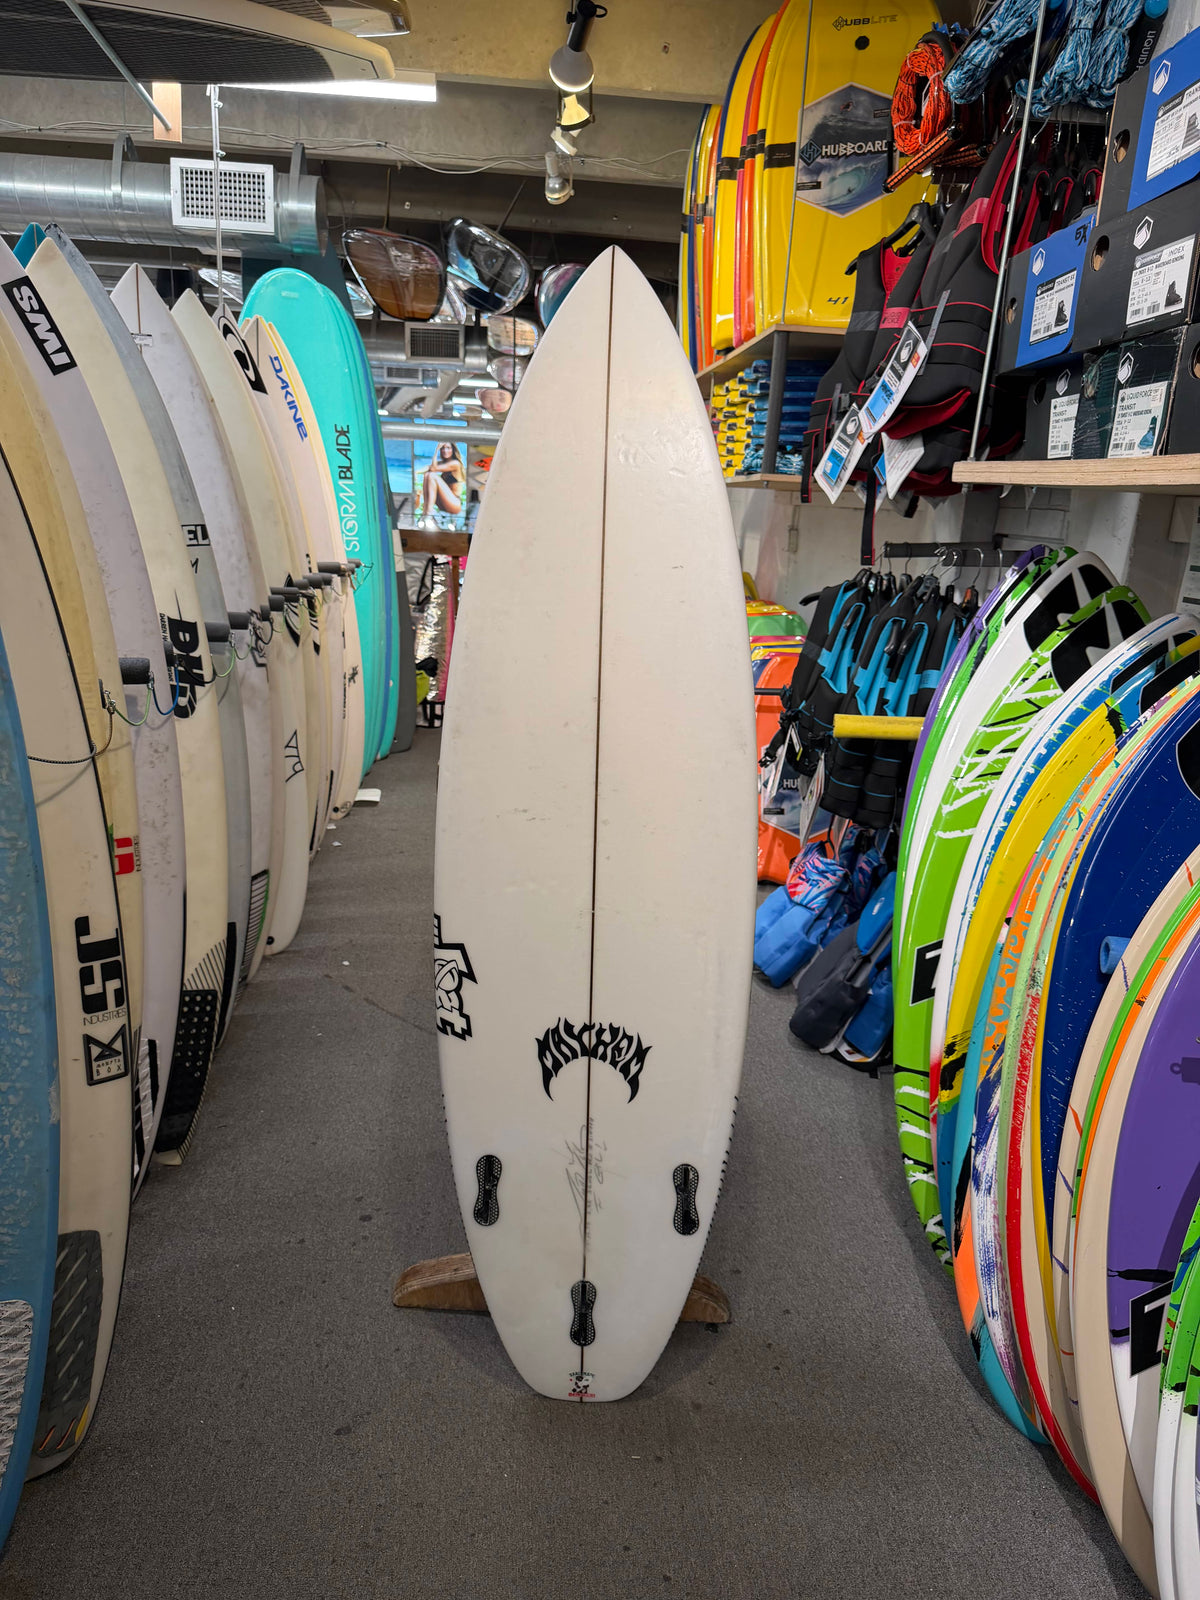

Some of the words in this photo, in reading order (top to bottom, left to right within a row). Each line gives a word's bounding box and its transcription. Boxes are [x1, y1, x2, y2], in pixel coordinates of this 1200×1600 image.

[269, 355, 308, 442] DAKINE
[75, 916, 125, 1014] JS
[82, 1008, 127, 1026] INDUSTRIES
[534, 1016, 653, 1104] MAYHEM
